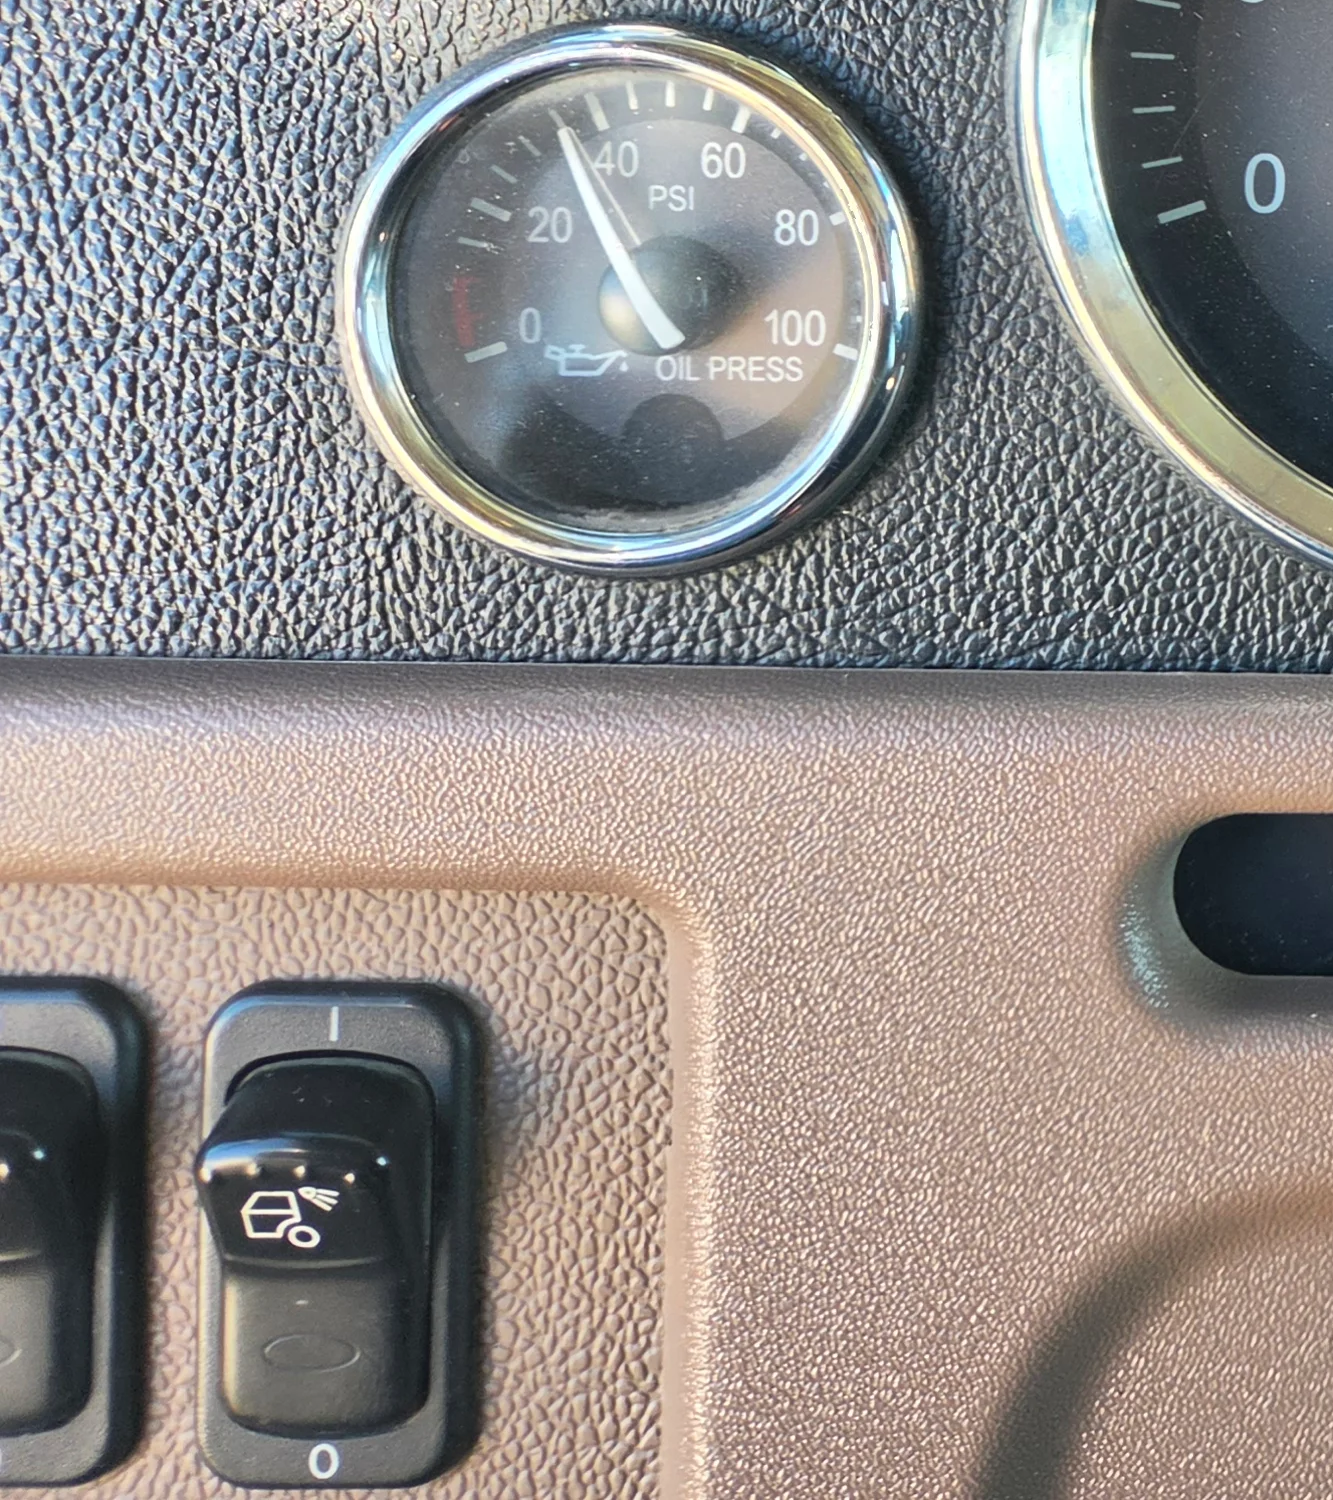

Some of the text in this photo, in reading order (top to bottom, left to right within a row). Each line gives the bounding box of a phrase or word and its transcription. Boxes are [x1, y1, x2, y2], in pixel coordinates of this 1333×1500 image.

[593, 140, 639, 178] 40
[701, 141, 747, 179] 60
[648, 185, 695, 211] PSI
[1243, 152, 1286, 214] 0
[528, 207, 573, 243] 20
[774, 209, 819, 246] 80
[519, 308, 541, 345] 0
[765, 309, 826, 346] 100
[656, 355, 804, 383] OIL PRESS
